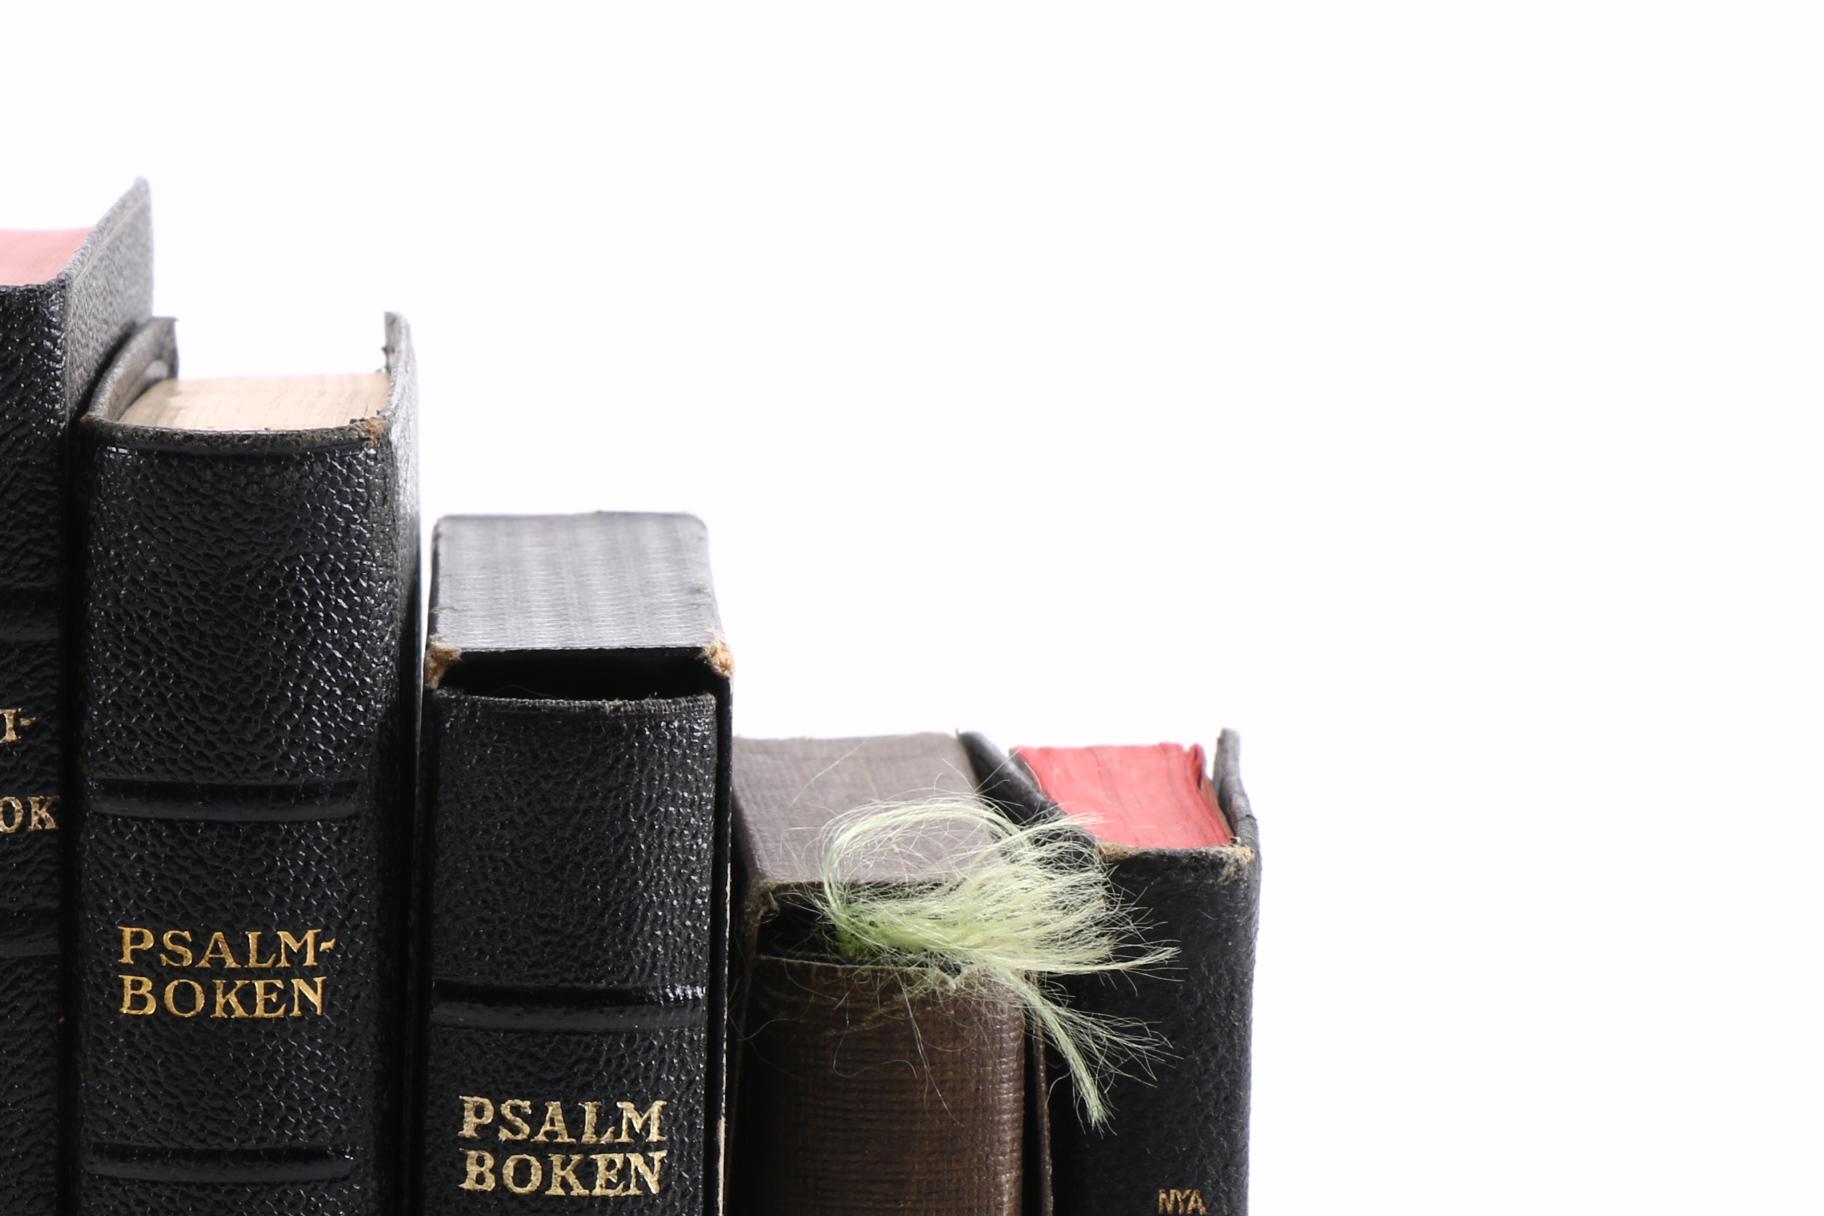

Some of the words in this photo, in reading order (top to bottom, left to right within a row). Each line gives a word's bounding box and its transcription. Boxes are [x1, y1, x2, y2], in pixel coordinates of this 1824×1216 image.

[118, 926, 337, 968] PSALM-
[118, 974, 327, 1018] BOKEN
[458, 1095, 668, 1144] PSALM
[458, 1148, 668, 1196] BOKEN
[1159, 1189, 1208, 1215] NYA
